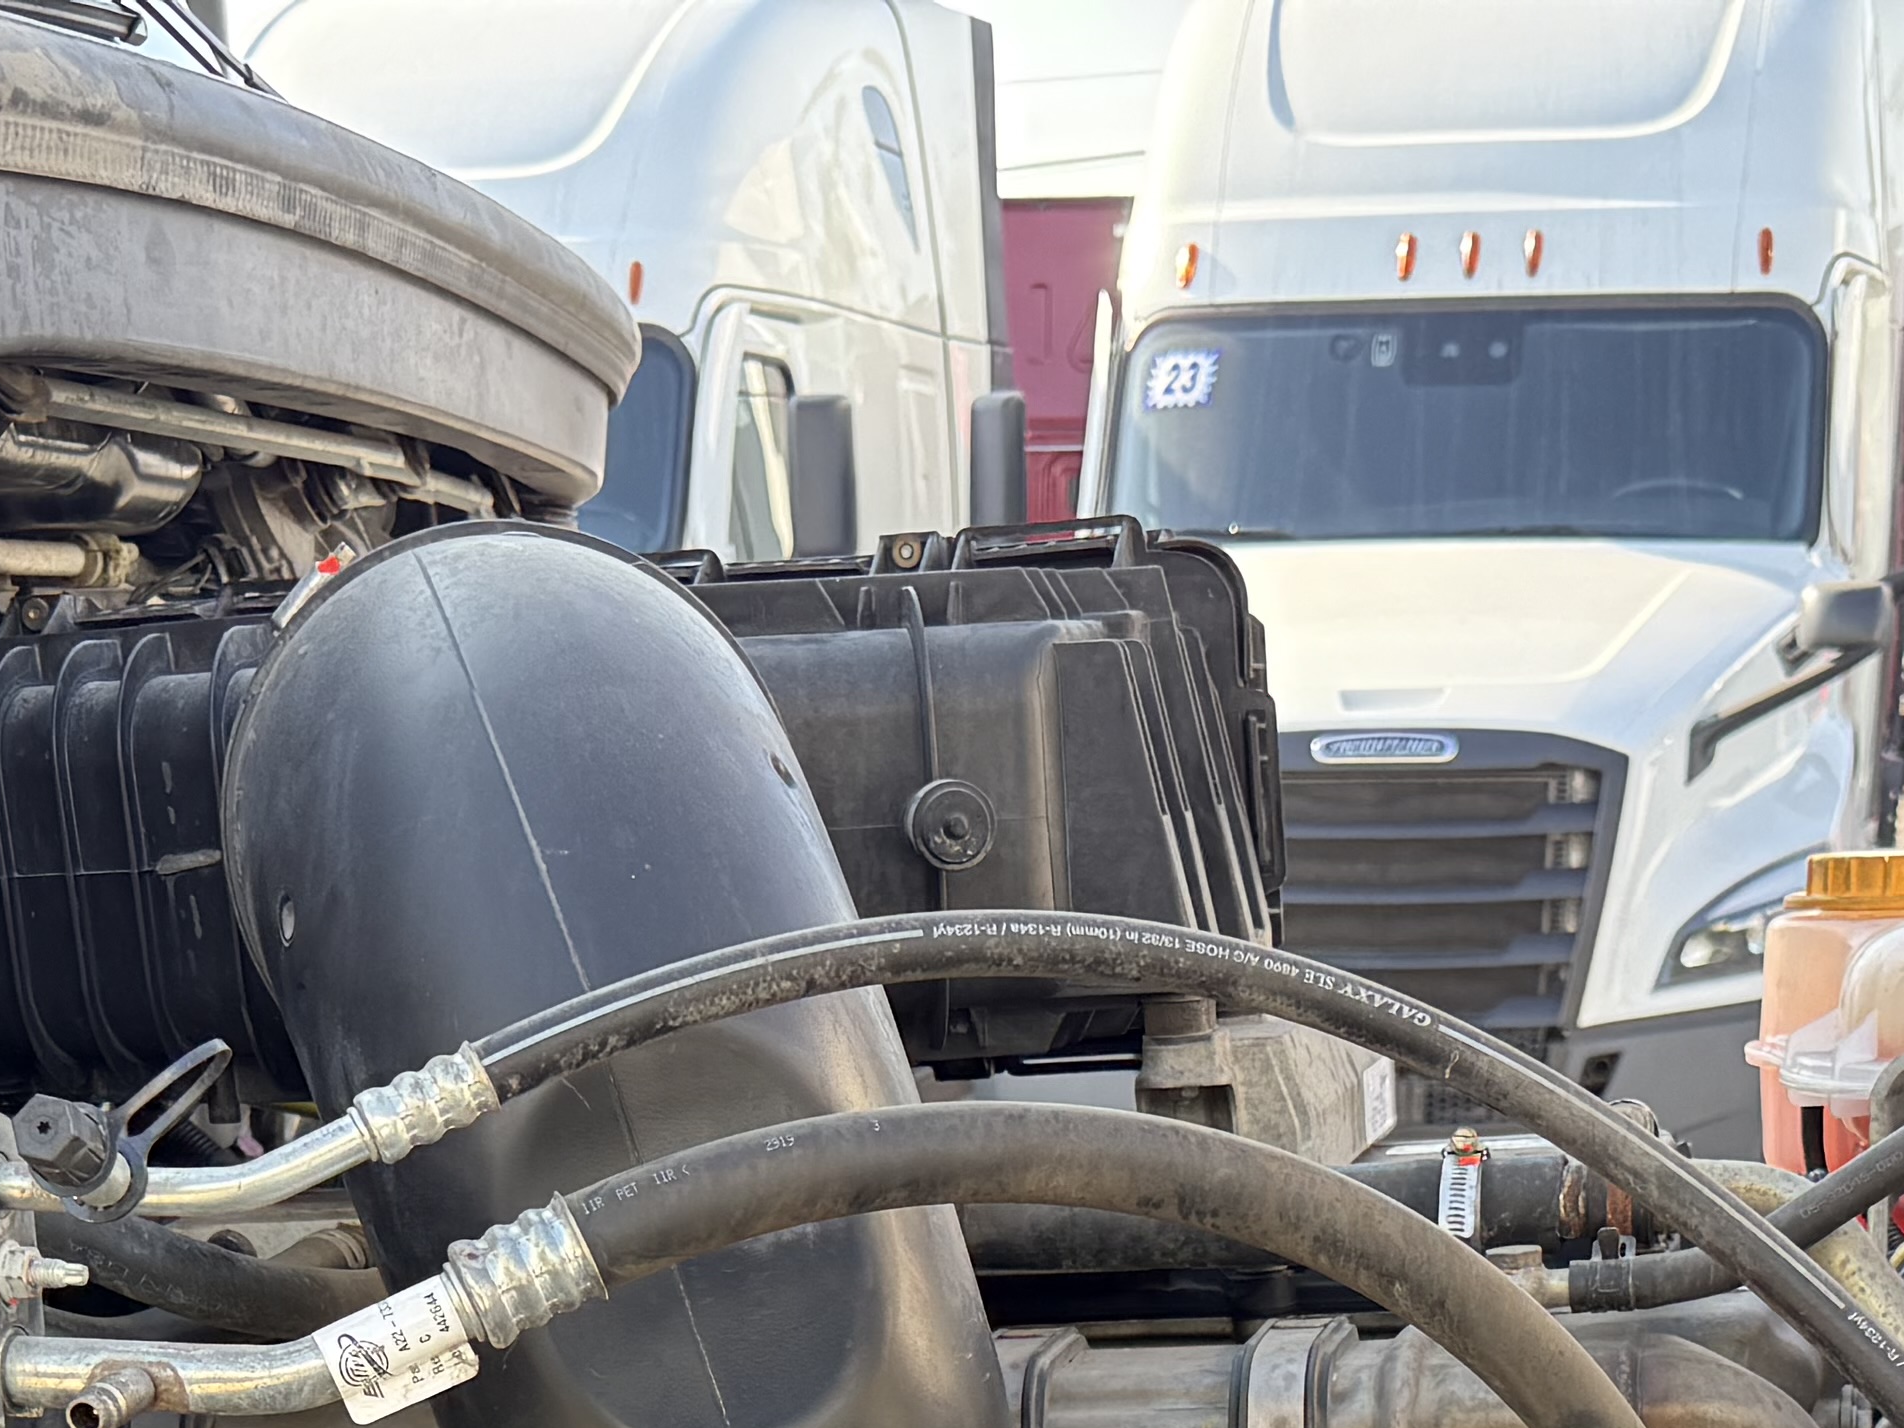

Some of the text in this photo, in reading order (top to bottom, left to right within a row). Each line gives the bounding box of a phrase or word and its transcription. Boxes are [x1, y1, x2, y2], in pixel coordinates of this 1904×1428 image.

[1163, 361, 1201, 395] 23
[1015, 922, 1062, 938] R-134a
[1068, 924, 1120, 943] (10mm)
[1124, 931, 1140, 945] in
[1185, 940, 1228, 959] HOSE
[1228, 948, 1259, 966] A/C
[1302, 968, 1336, 988] SLE
[1336, 983, 1431, 1027] GALAXY
[615, 1180, 640, 1202] PET
[419, 1333, 431, 1344] C
